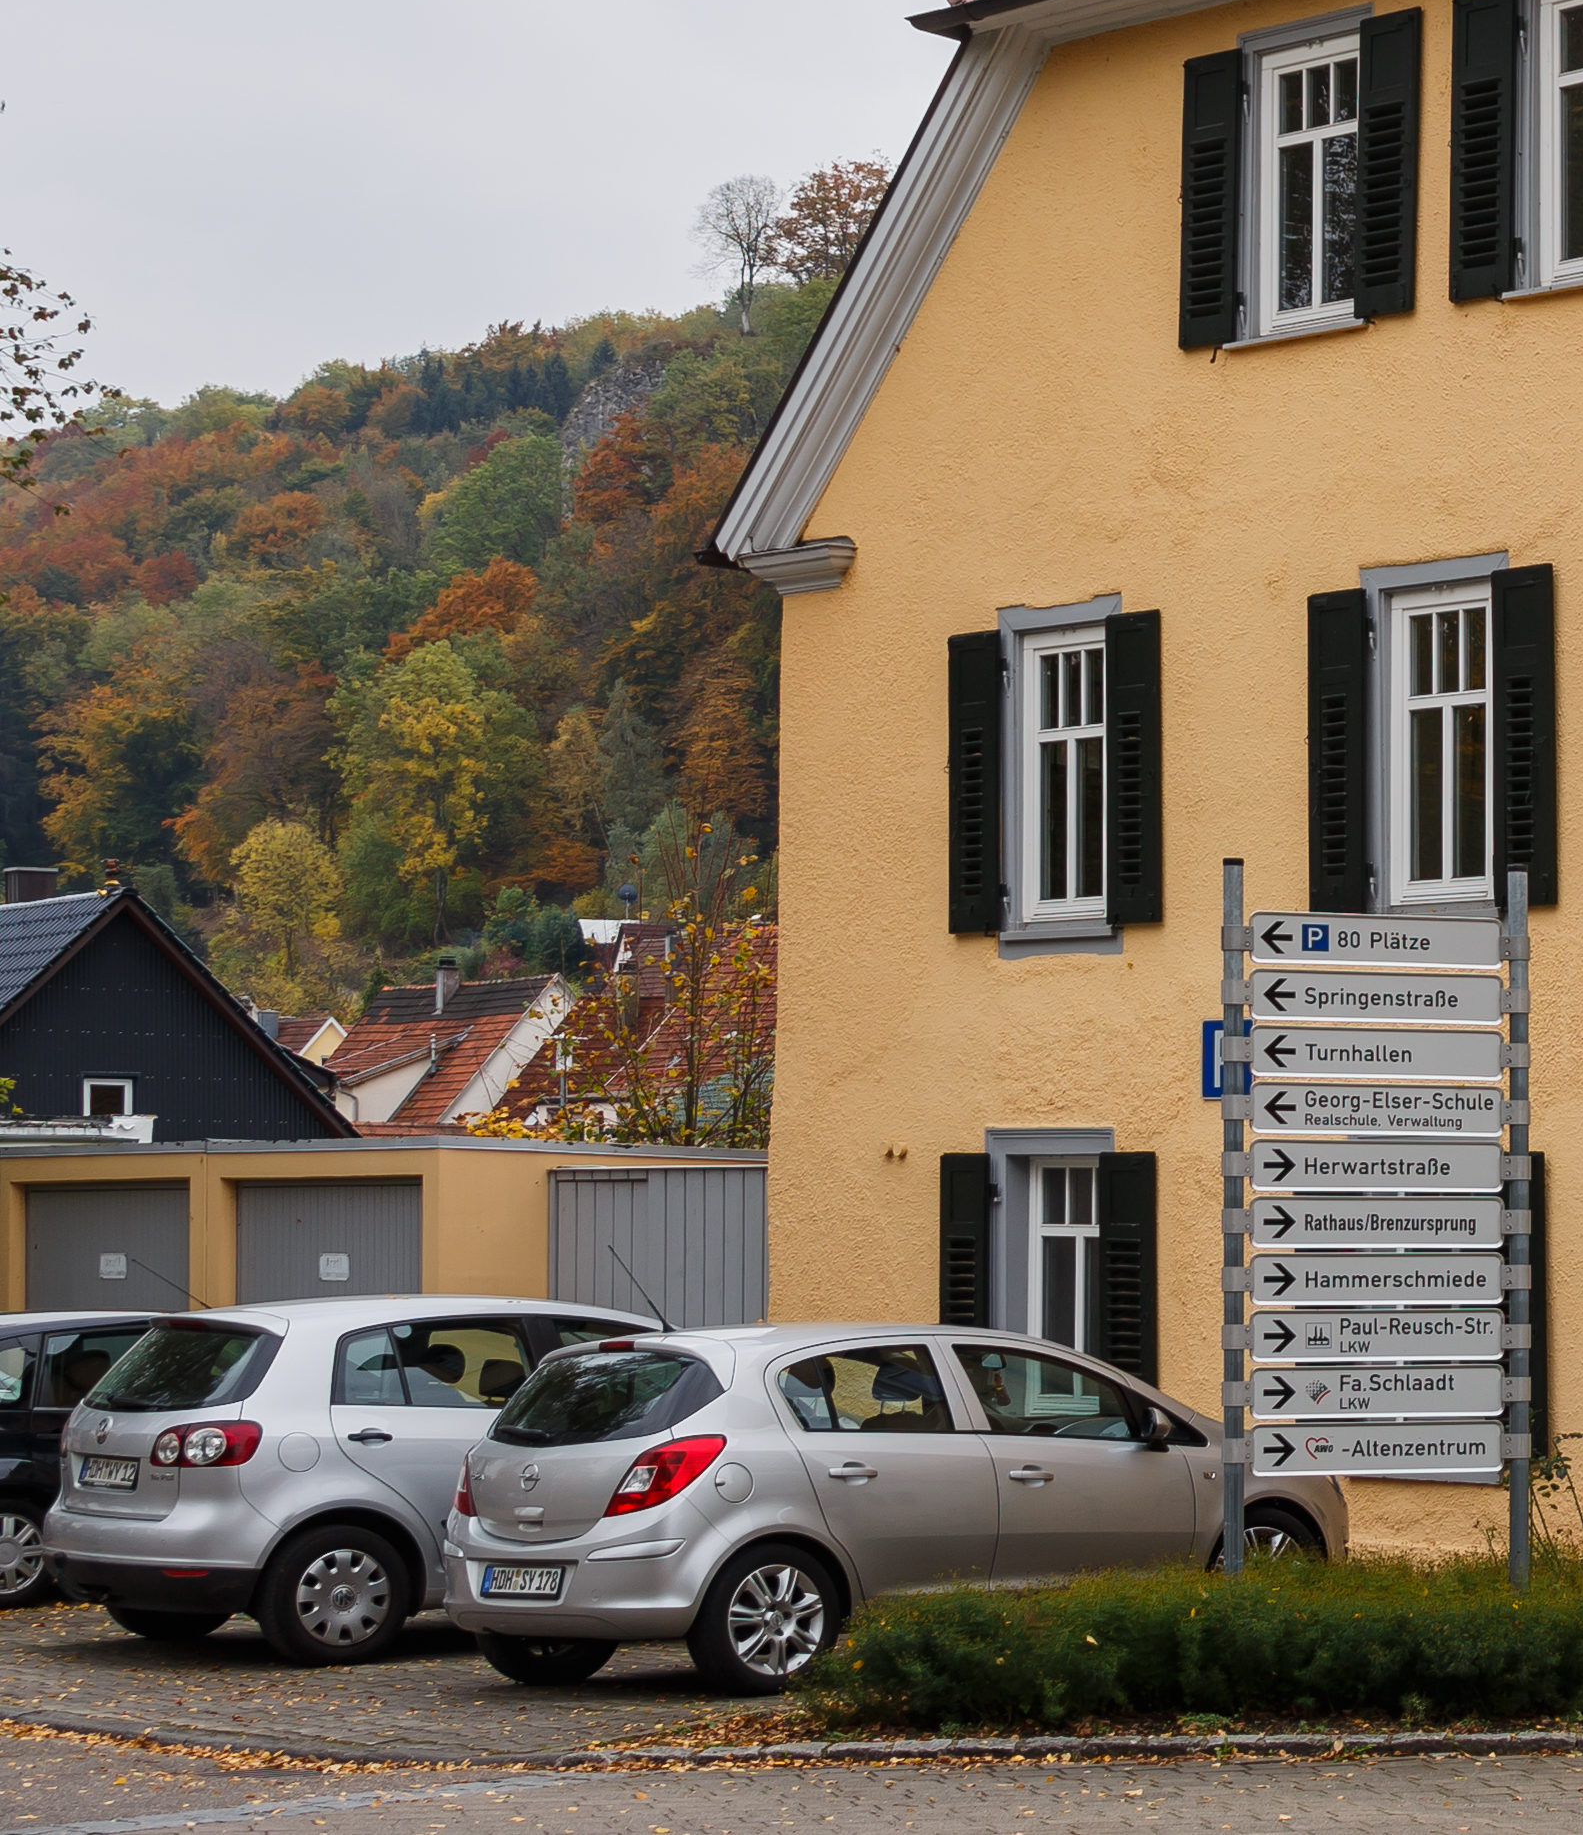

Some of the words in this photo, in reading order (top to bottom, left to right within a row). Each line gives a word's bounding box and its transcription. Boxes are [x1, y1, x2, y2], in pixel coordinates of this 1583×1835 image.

[1337, 930, 1361, 949] 80
[1370, 931, 1431, 951] Plätze
[1304, 987, 1459, 1011] Springenstraße
[1304, 1042, 1412, 1063] Turnhallen
[1304, 1090, 1495, 1112] Georg-Elser-Schule
[1304, 1113, 1381, 1128] Realschule,
[1387, 1114, 1463, 1131] Verwaltung
[1304, 1157, 1451, 1176] Herwartstraße
[1304, 1213, 1477, 1235] Rathaus/Brenzursprung
[1305, 1270, 1487, 1289] Hammerschmiede
[1339, 1317, 1494, 1336] Paul-Reusch-Str.
[1339, 1340, 1371, 1354] LKW
[1339, 1397, 1371, 1410] LKW
[1314, 1444, 1334, 1453] AWO
[490, 1569, 515, 1591] HDH
[519, 1569, 537, 1591] SY
[535, 1570, 559, 1592] 178
